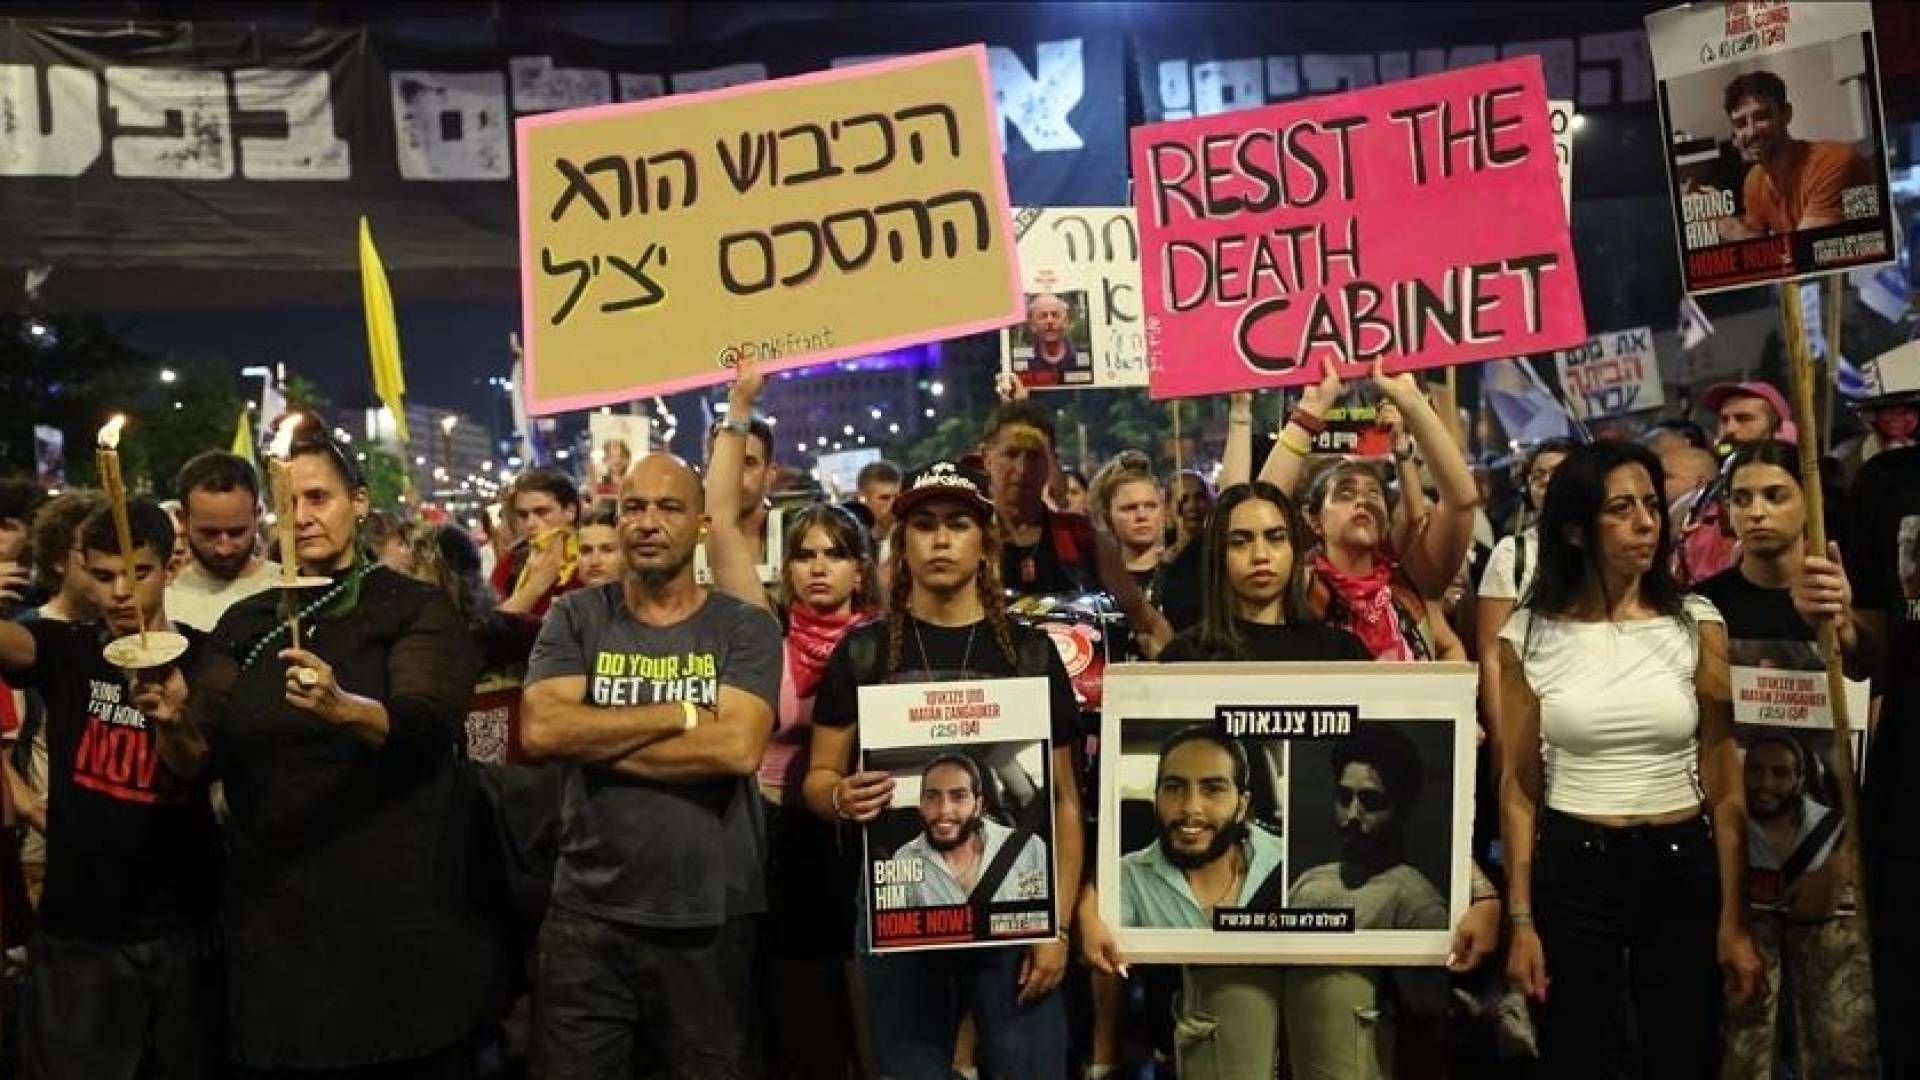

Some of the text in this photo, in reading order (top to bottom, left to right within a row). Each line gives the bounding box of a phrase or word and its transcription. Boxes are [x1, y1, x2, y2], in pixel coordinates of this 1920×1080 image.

[716, 103, 961, 194] הכיבוש
[1146, 84, 1530, 228] RESIST THE
[1682, 189, 1736, 222] BRING
[718, 190, 991, 296] ההסכם
[1686, 218, 1720, 250] HIM
[1161, 216, 1361, 314] DEATH
[541, 242, 668, 327] יציל
[1233, 252, 1559, 377] CABINET
[597, 651, 625, 676] DO
[628, 653, 678, 679] YOUR
[594, 676, 644, 706] GET
[1221, 711, 1350, 738] מתן צנגאוקר
[874, 857, 923, 884] BRING
[875, 885, 906, 910] HIM
[876, 911, 922, 937] HOME
[926, 905, 974, 935] NOW!
